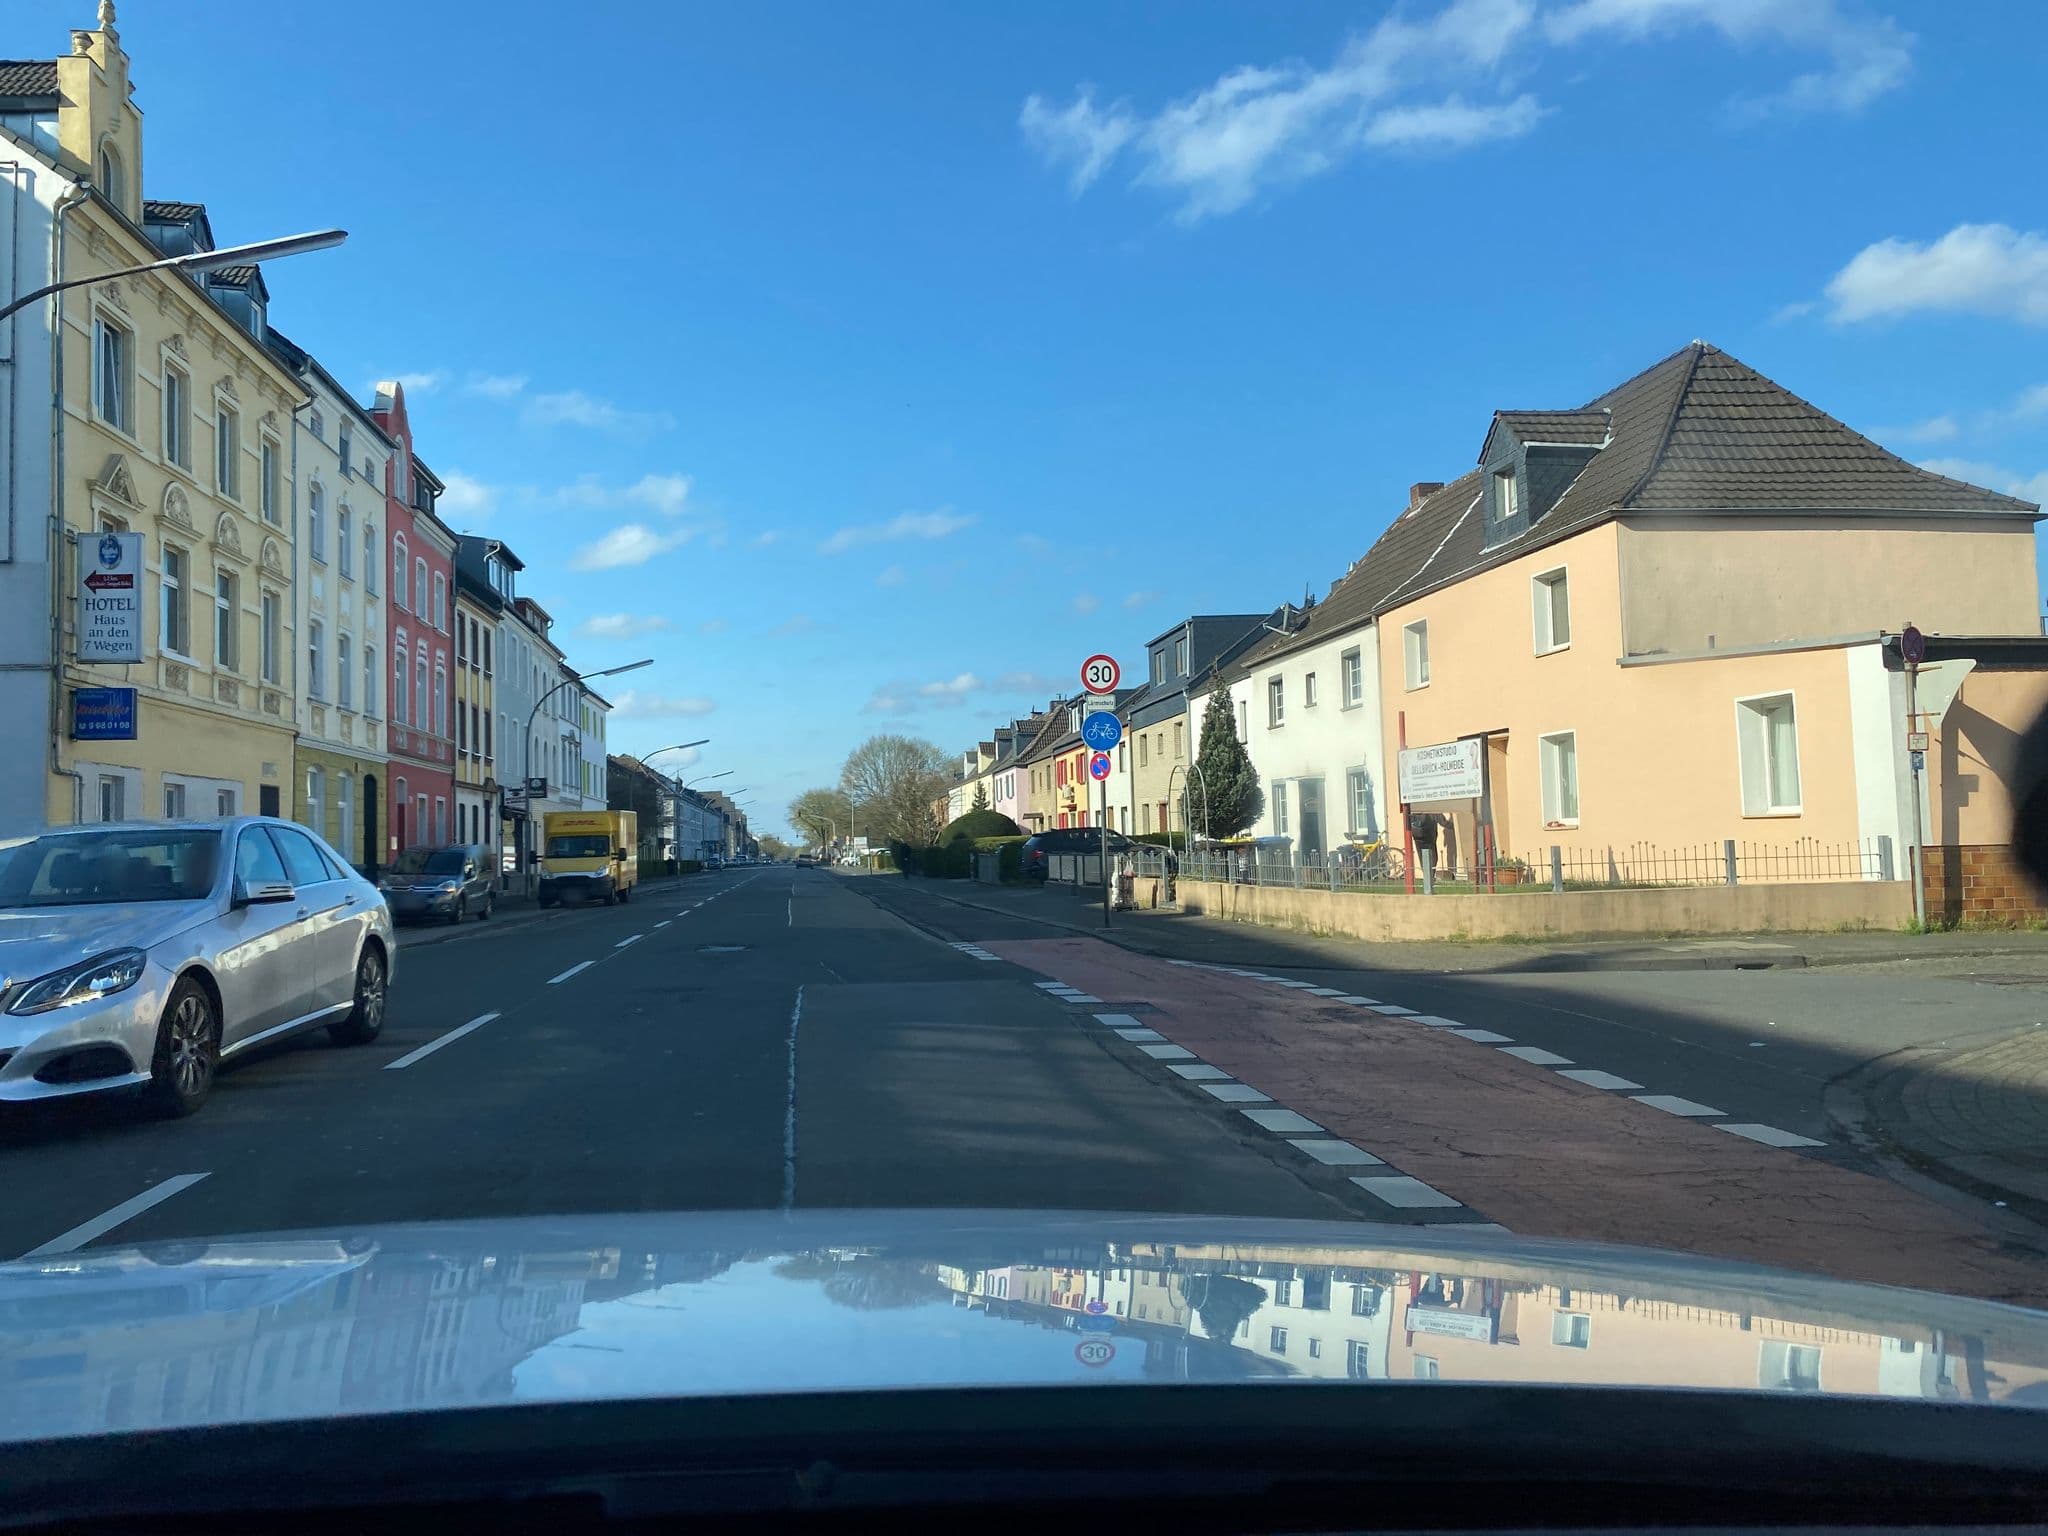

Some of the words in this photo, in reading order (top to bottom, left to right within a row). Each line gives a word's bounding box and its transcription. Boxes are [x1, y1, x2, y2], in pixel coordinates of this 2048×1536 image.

[85, 598, 135, 611] HOTEL
[94, 614, 126, 625] Haus
[88, 629, 104, 637] an
[107, 627, 129, 638] den
[84, 640, 91, 650] 7
[94, 640, 133, 653] Wegen
[1089, 665, 1112, 683] 30
[1416, 745, 1458, 760] KOSMETIKSTUDIO
